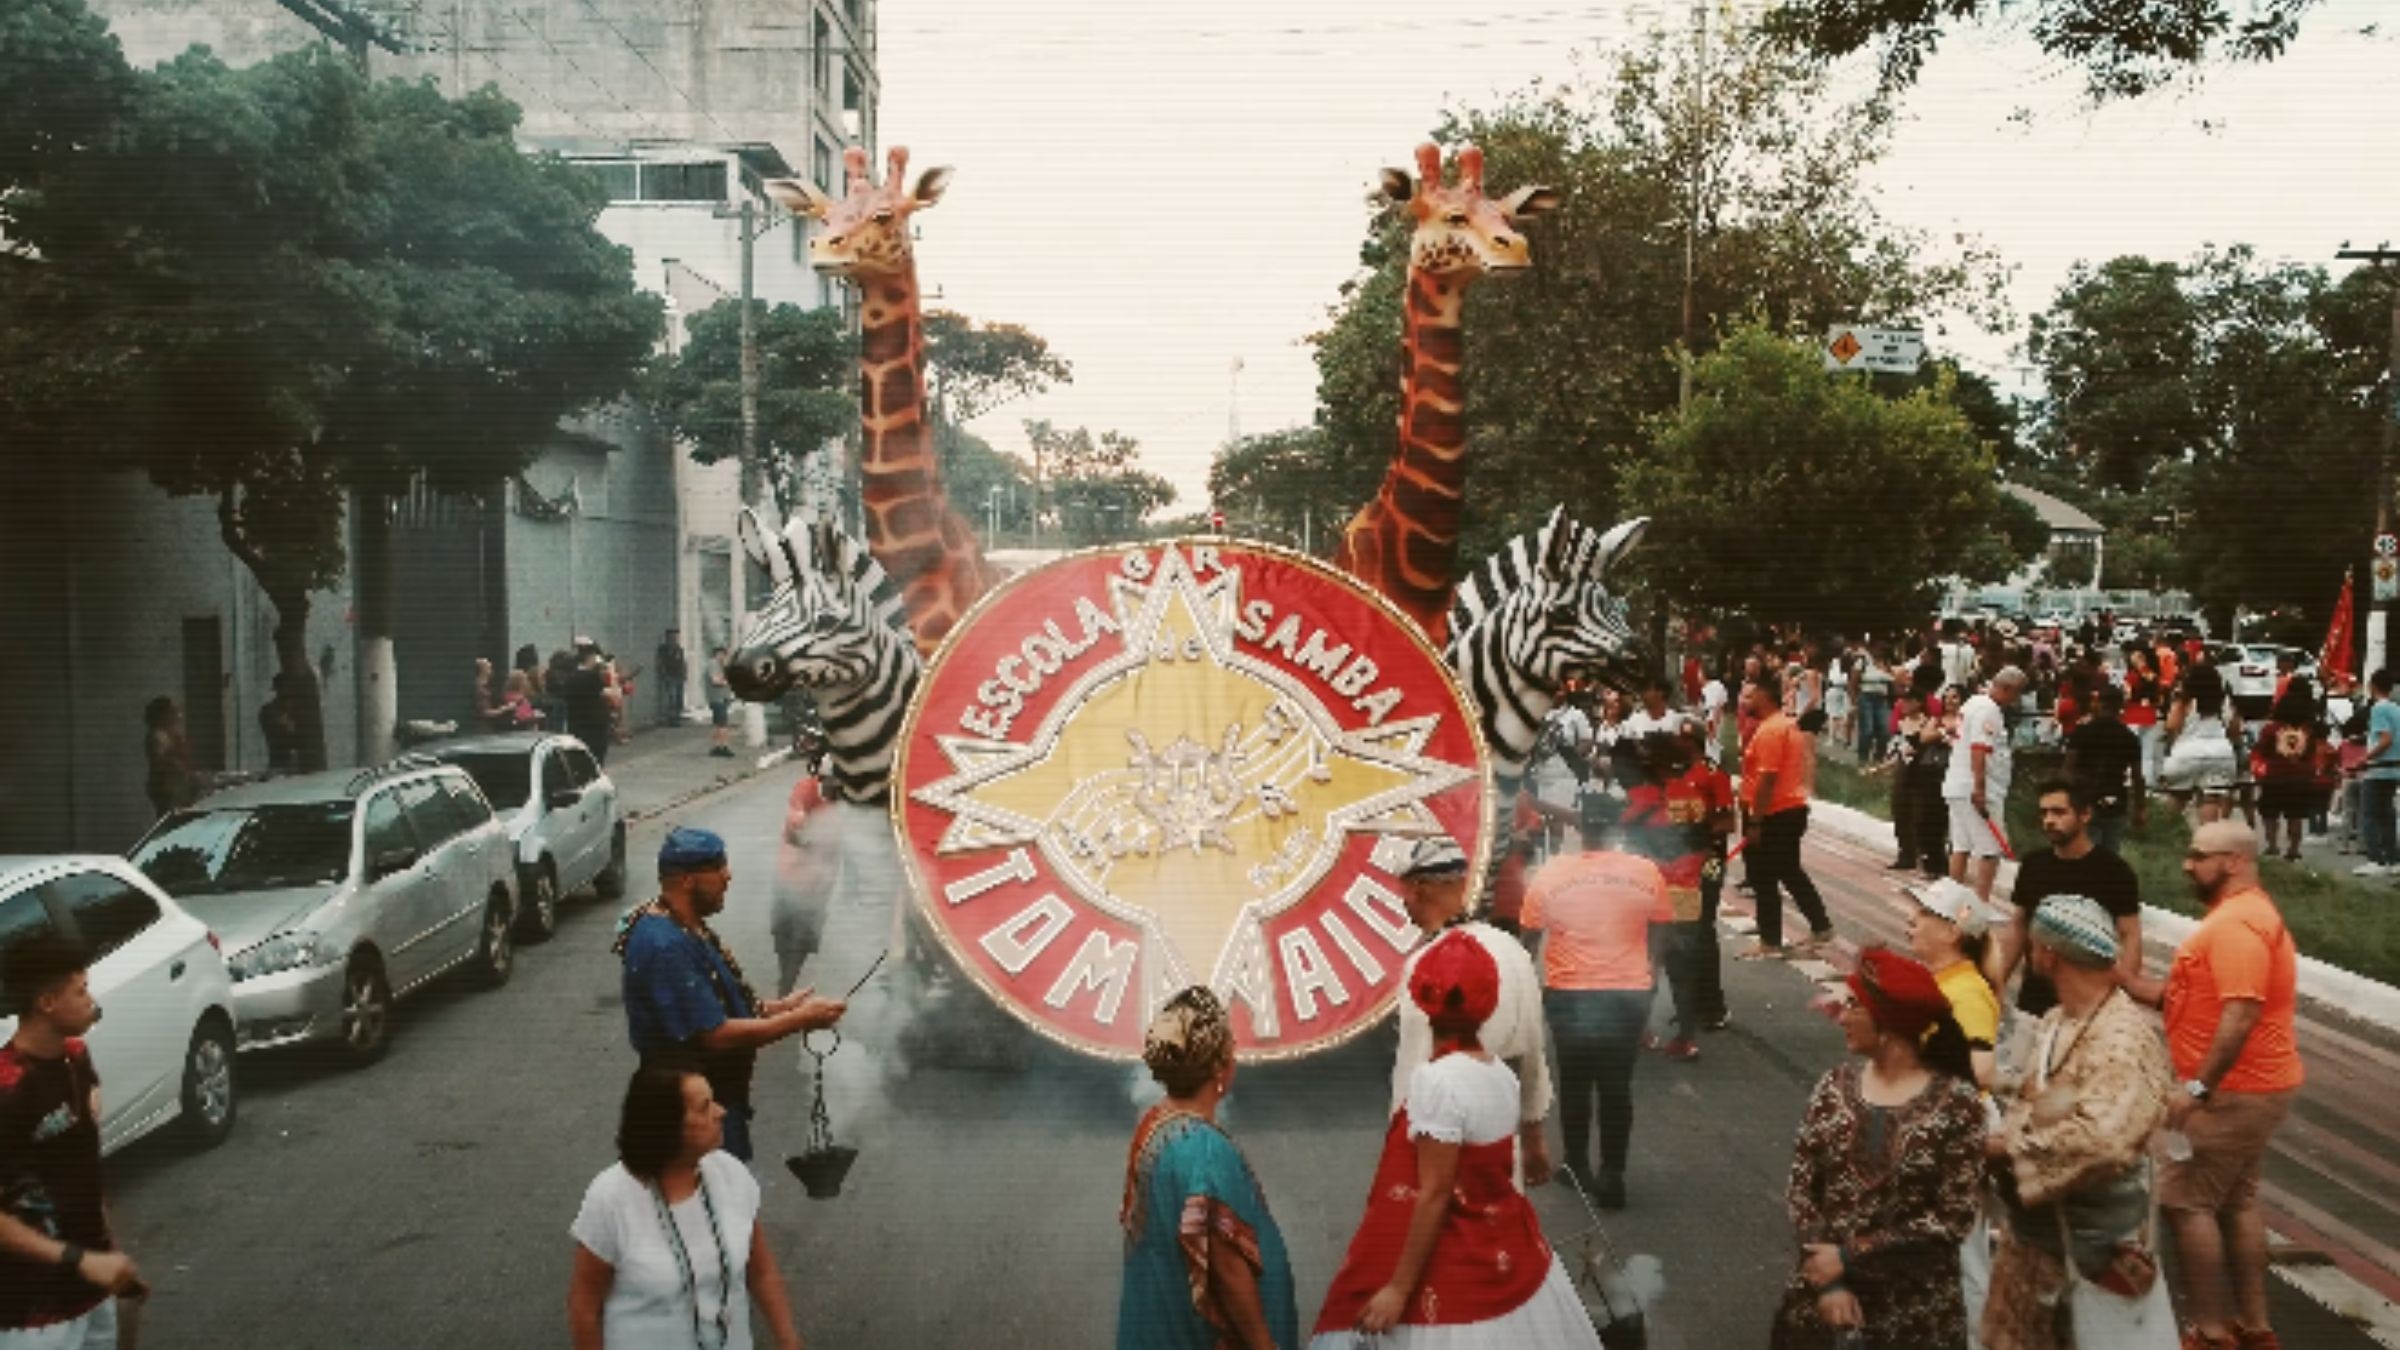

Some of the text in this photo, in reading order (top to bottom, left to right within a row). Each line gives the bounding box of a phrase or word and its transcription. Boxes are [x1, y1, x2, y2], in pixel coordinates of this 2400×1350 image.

[1193, 545, 1226, 575] R
[959, 595, 1405, 740] ESCOLA de SAMBA
[944, 847, 1139, 1025] TOM
